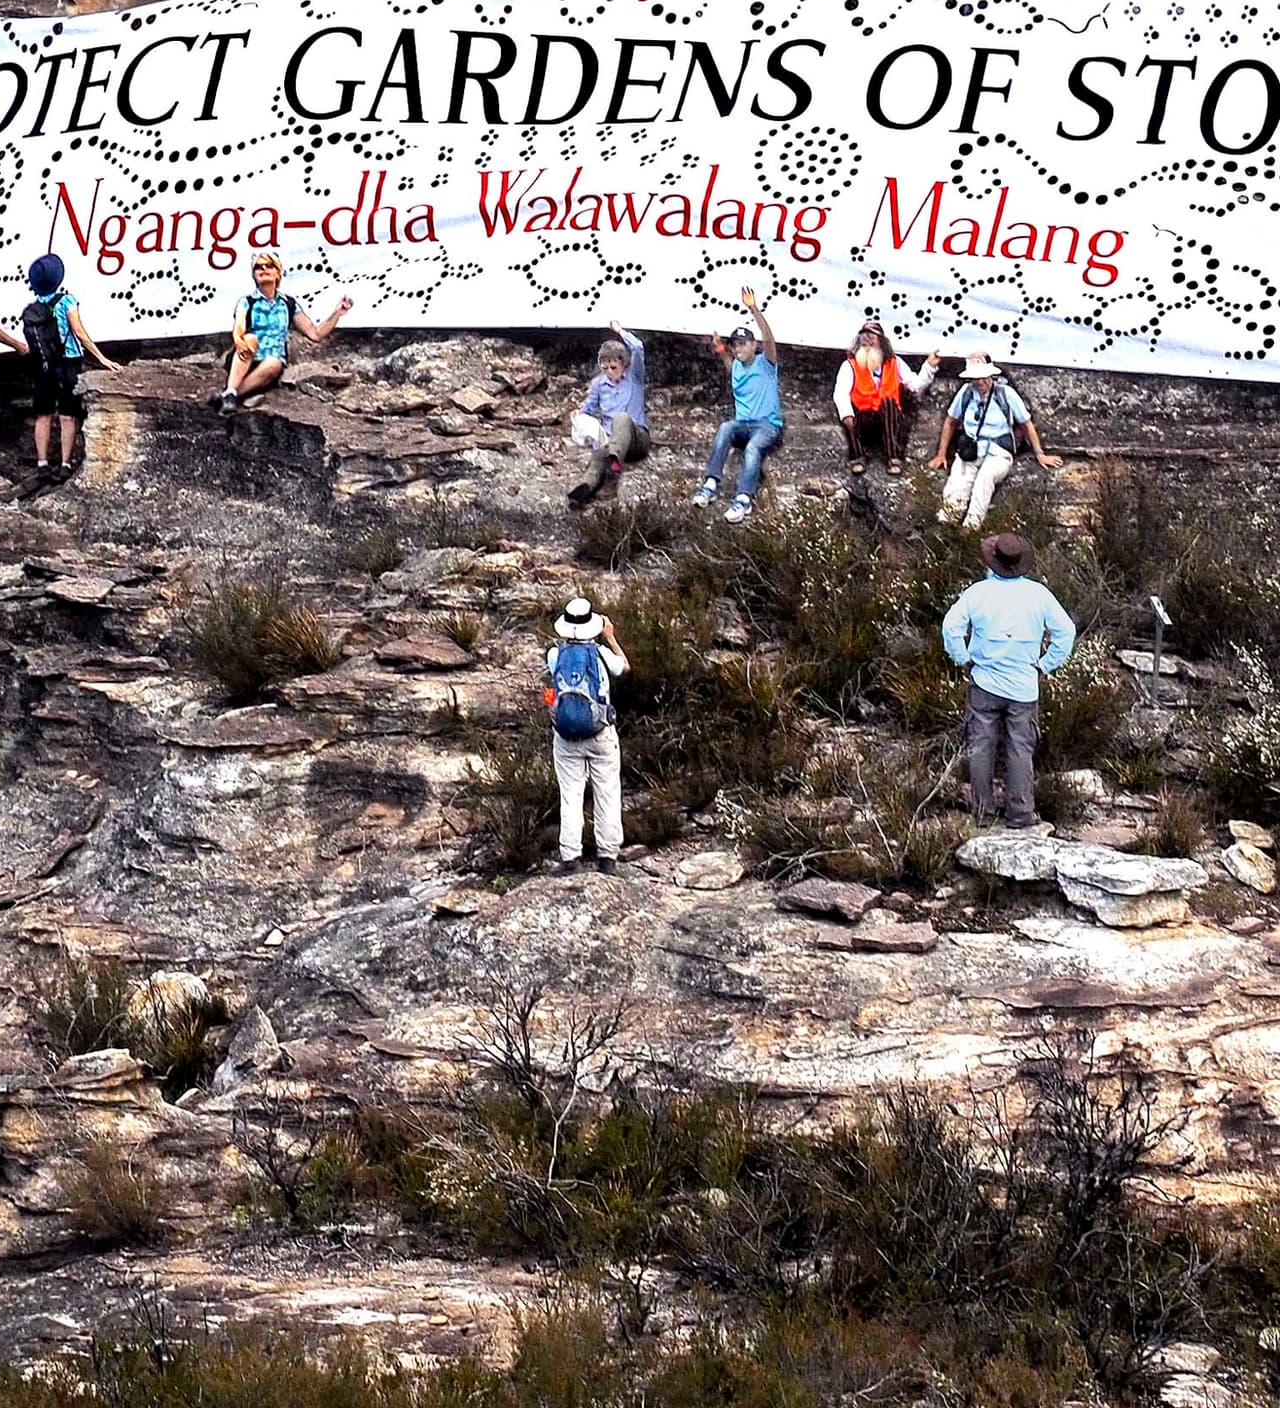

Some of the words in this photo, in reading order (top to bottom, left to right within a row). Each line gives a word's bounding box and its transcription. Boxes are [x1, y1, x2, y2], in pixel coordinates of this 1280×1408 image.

[284, 26, 827, 125] GARDENS
[866, 44, 1020, 135] OF
[48, 170, 439, 276] Nganga-dha
[477, 164, 831, 263] Walawalang
[864, 176, 1128, 288] Malang
